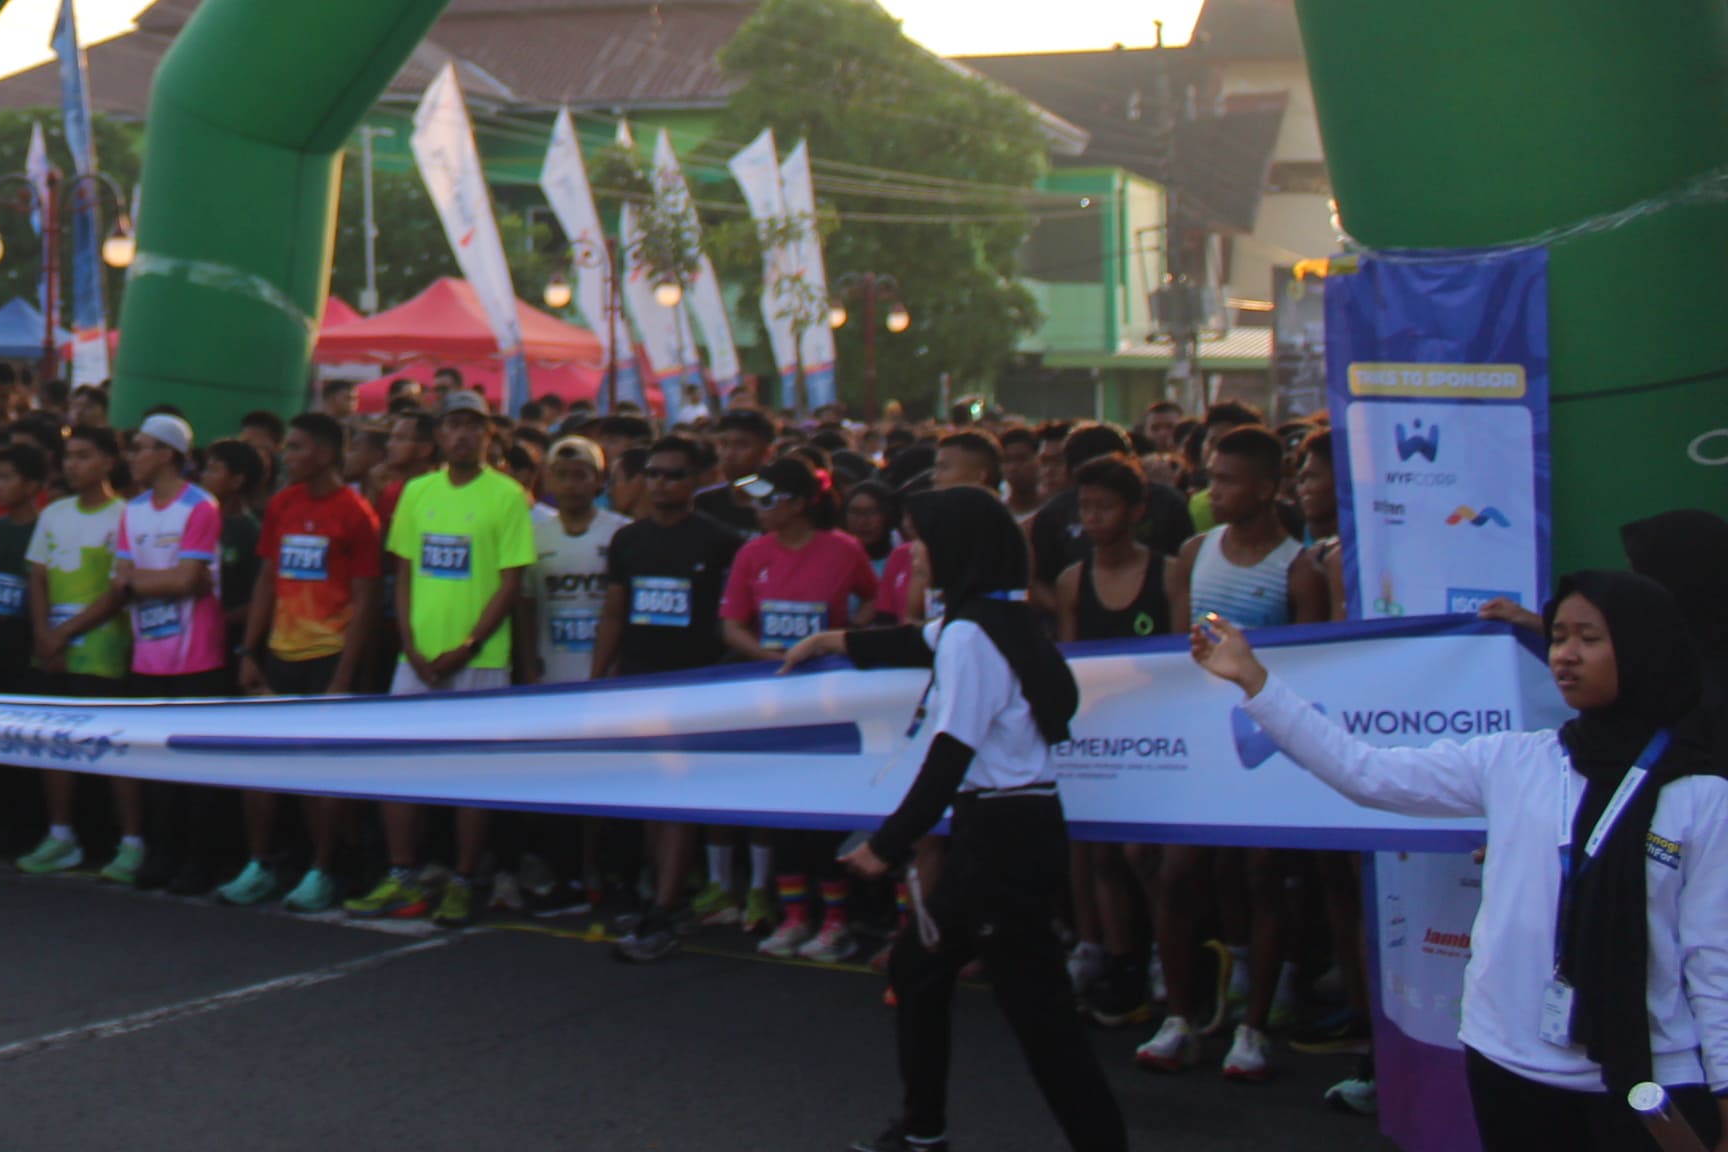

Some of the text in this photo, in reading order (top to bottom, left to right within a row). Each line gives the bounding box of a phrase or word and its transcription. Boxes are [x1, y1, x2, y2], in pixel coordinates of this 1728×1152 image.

[1427, 372, 1517, 388] SPONSOR
[1342, 708, 1512, 735] WONOGIRI
[1047, 736, 1189, 757] EMENPORA
